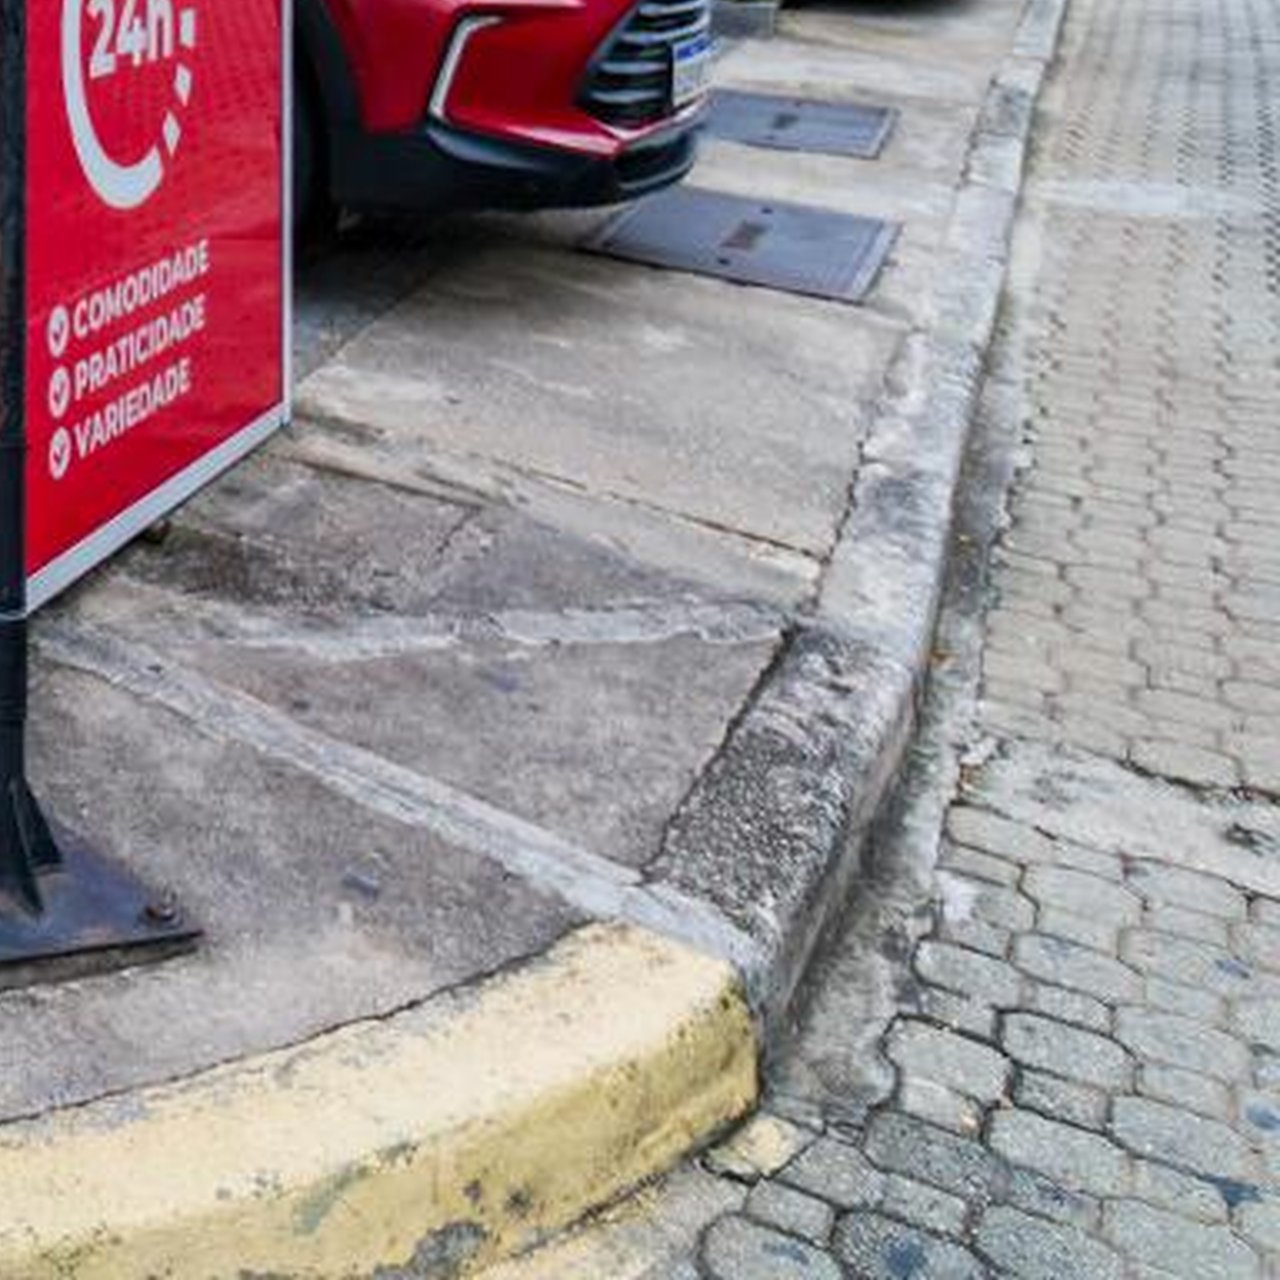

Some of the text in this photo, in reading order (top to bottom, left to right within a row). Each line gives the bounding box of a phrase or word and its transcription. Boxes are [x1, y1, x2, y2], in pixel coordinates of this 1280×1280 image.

[73, 239, 209, 339] COMODIDADE
[75, 293, 206, 400] PRATICIDADE
[74, 358, 190, 459] VARIEDADE
